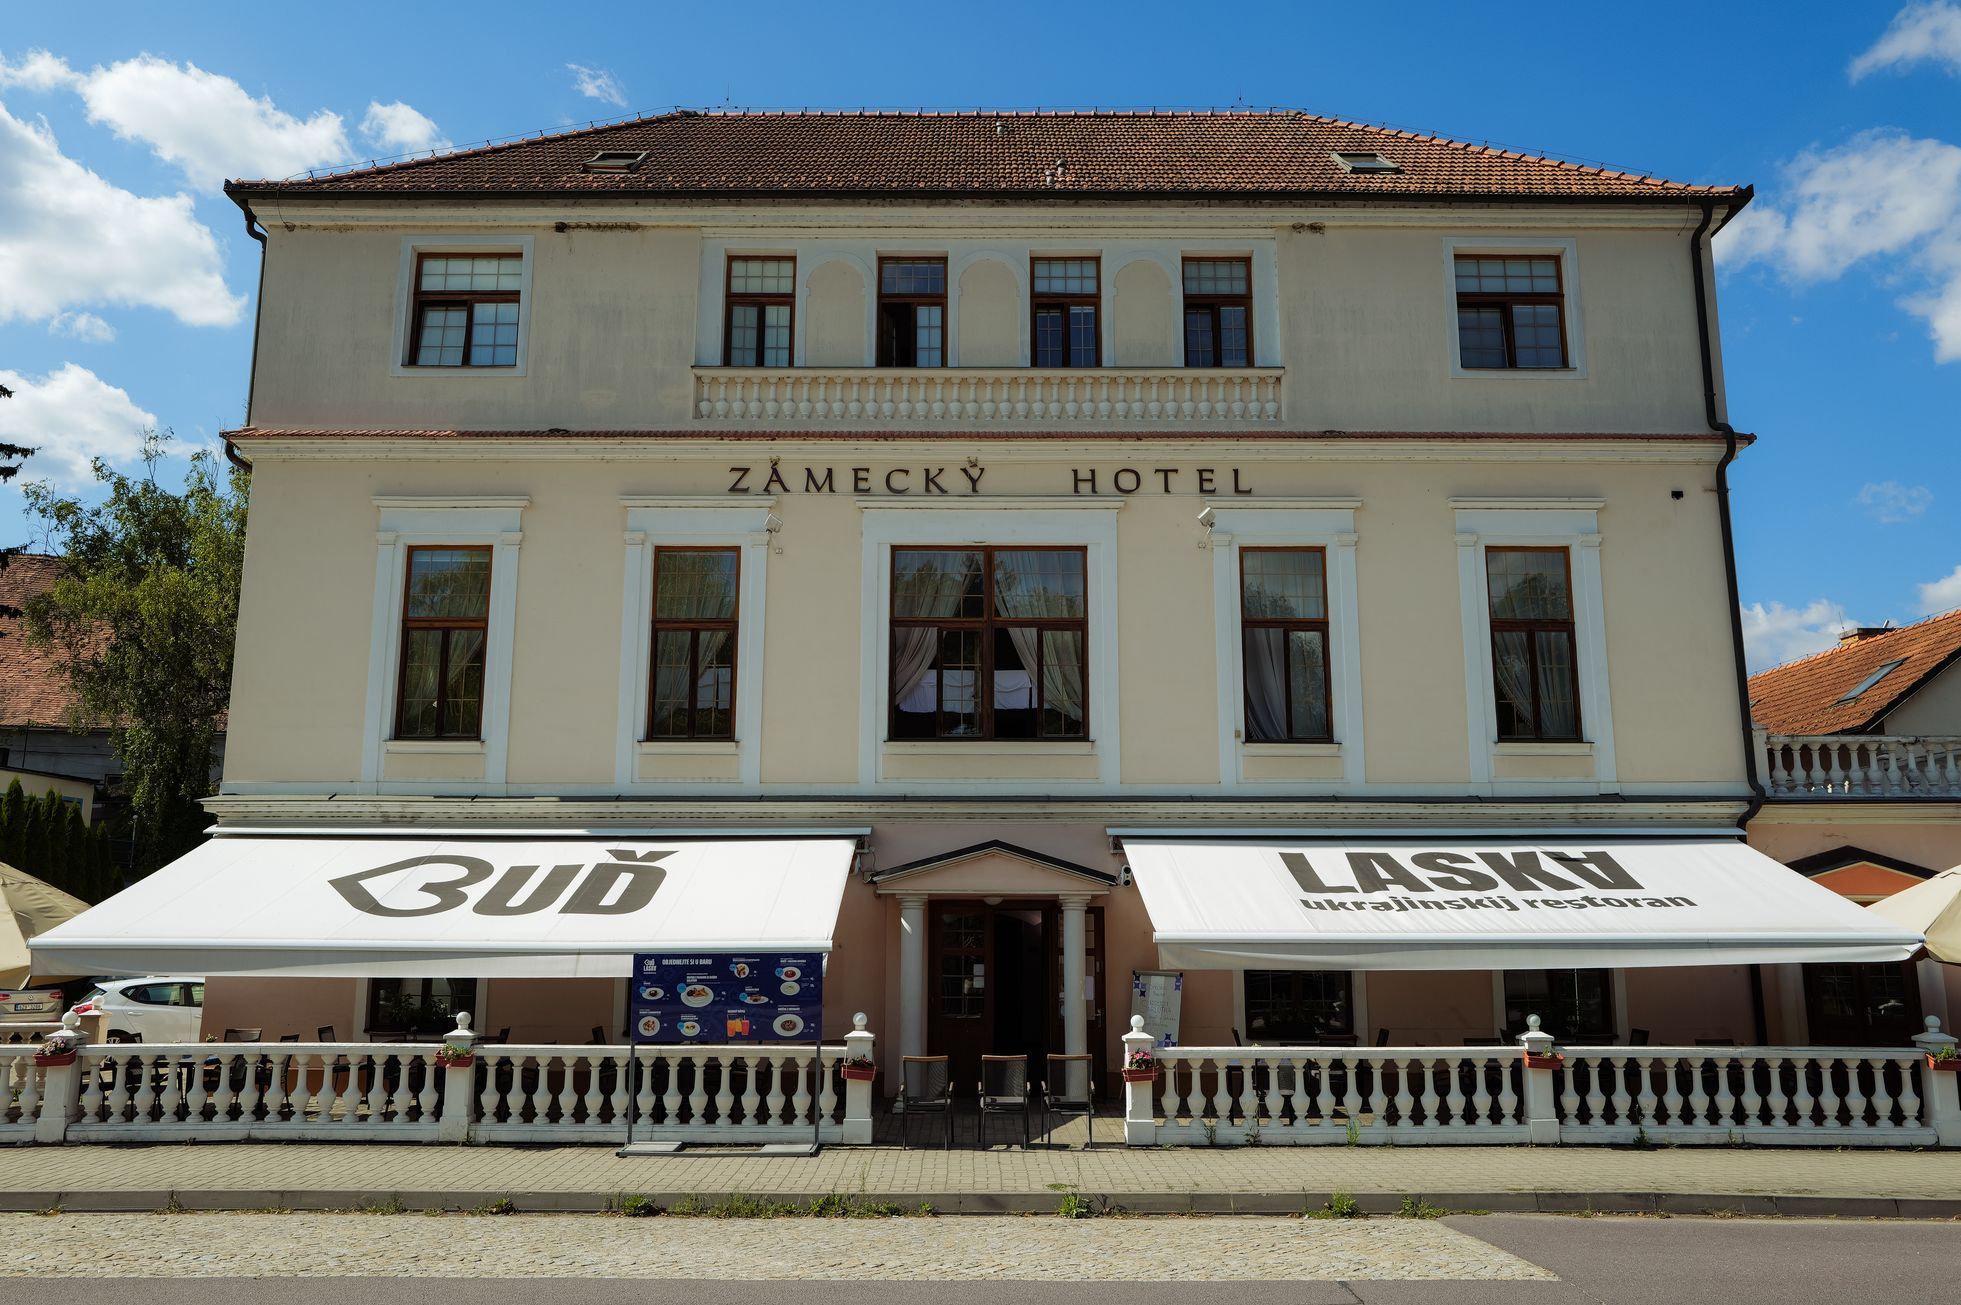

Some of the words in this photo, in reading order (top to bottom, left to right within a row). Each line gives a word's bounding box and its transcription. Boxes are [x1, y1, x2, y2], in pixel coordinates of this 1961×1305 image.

[1072, 468, 1252, 494] HOTEL
[1299, 895, 1520, 912] ukrajinskij
[1519, 894, 1699, 911] restoran
